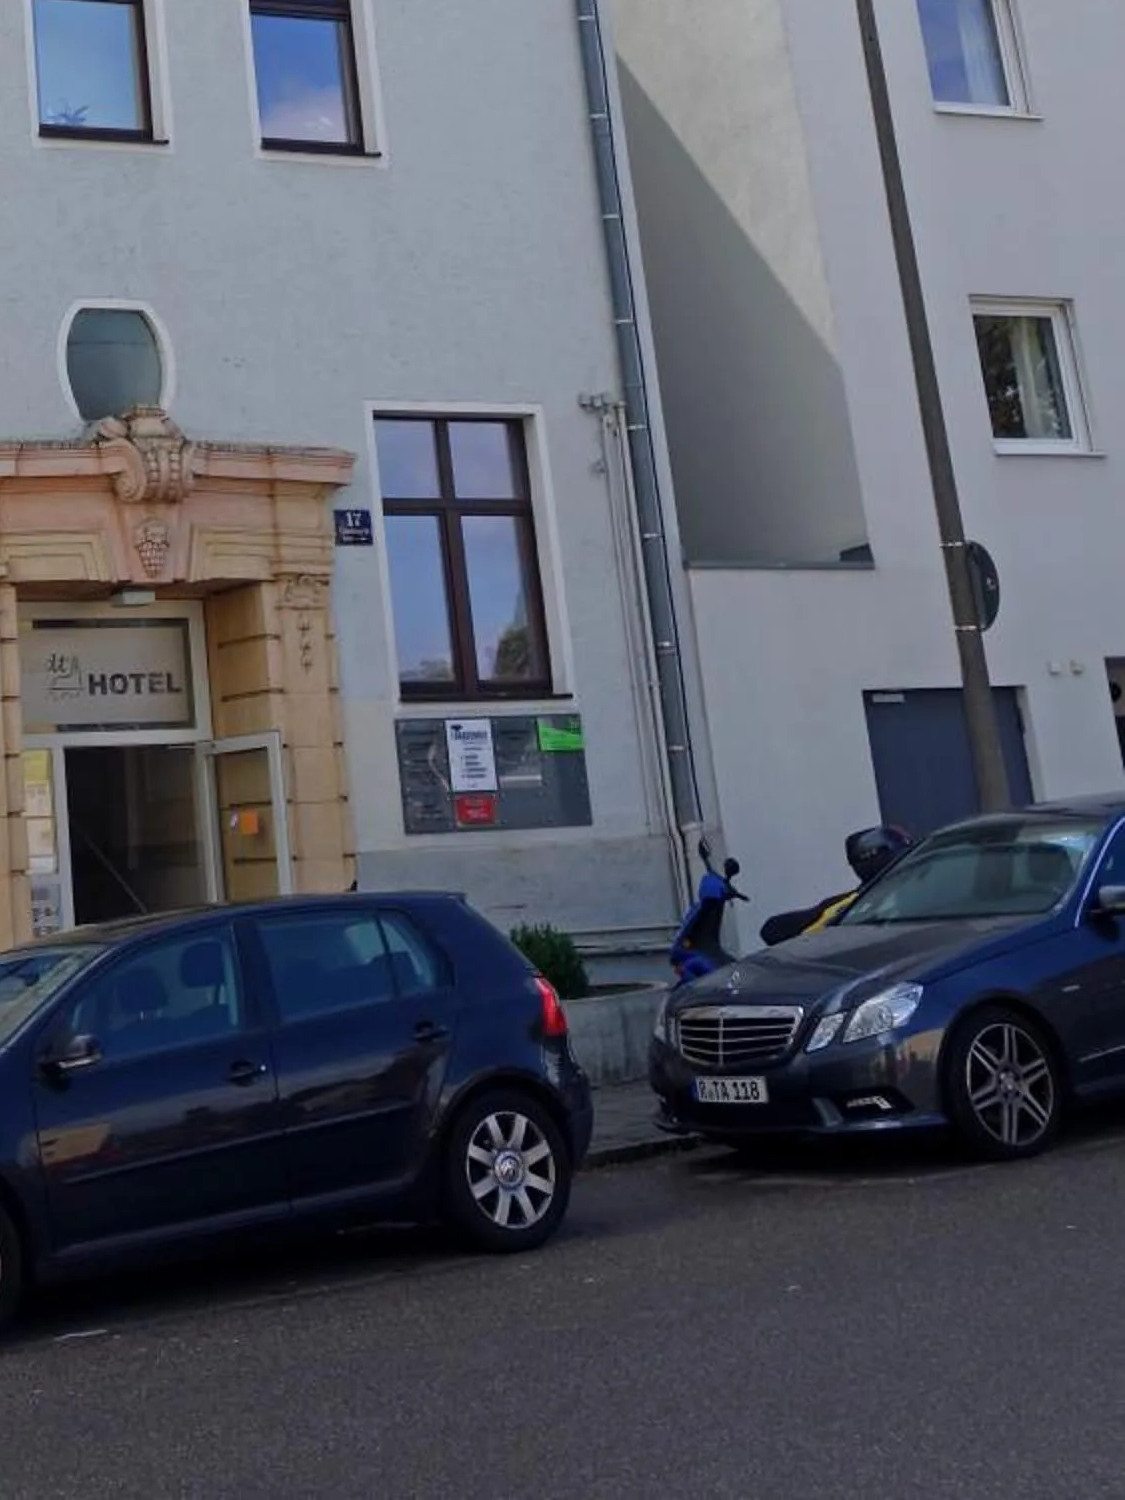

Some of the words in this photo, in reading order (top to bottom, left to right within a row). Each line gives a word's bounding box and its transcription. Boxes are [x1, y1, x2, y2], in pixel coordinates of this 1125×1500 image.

[346, 511, 362, 527] 17
[88, 672, 183, 696] HOTEL
[733, 1081, 760, 1100] 118
